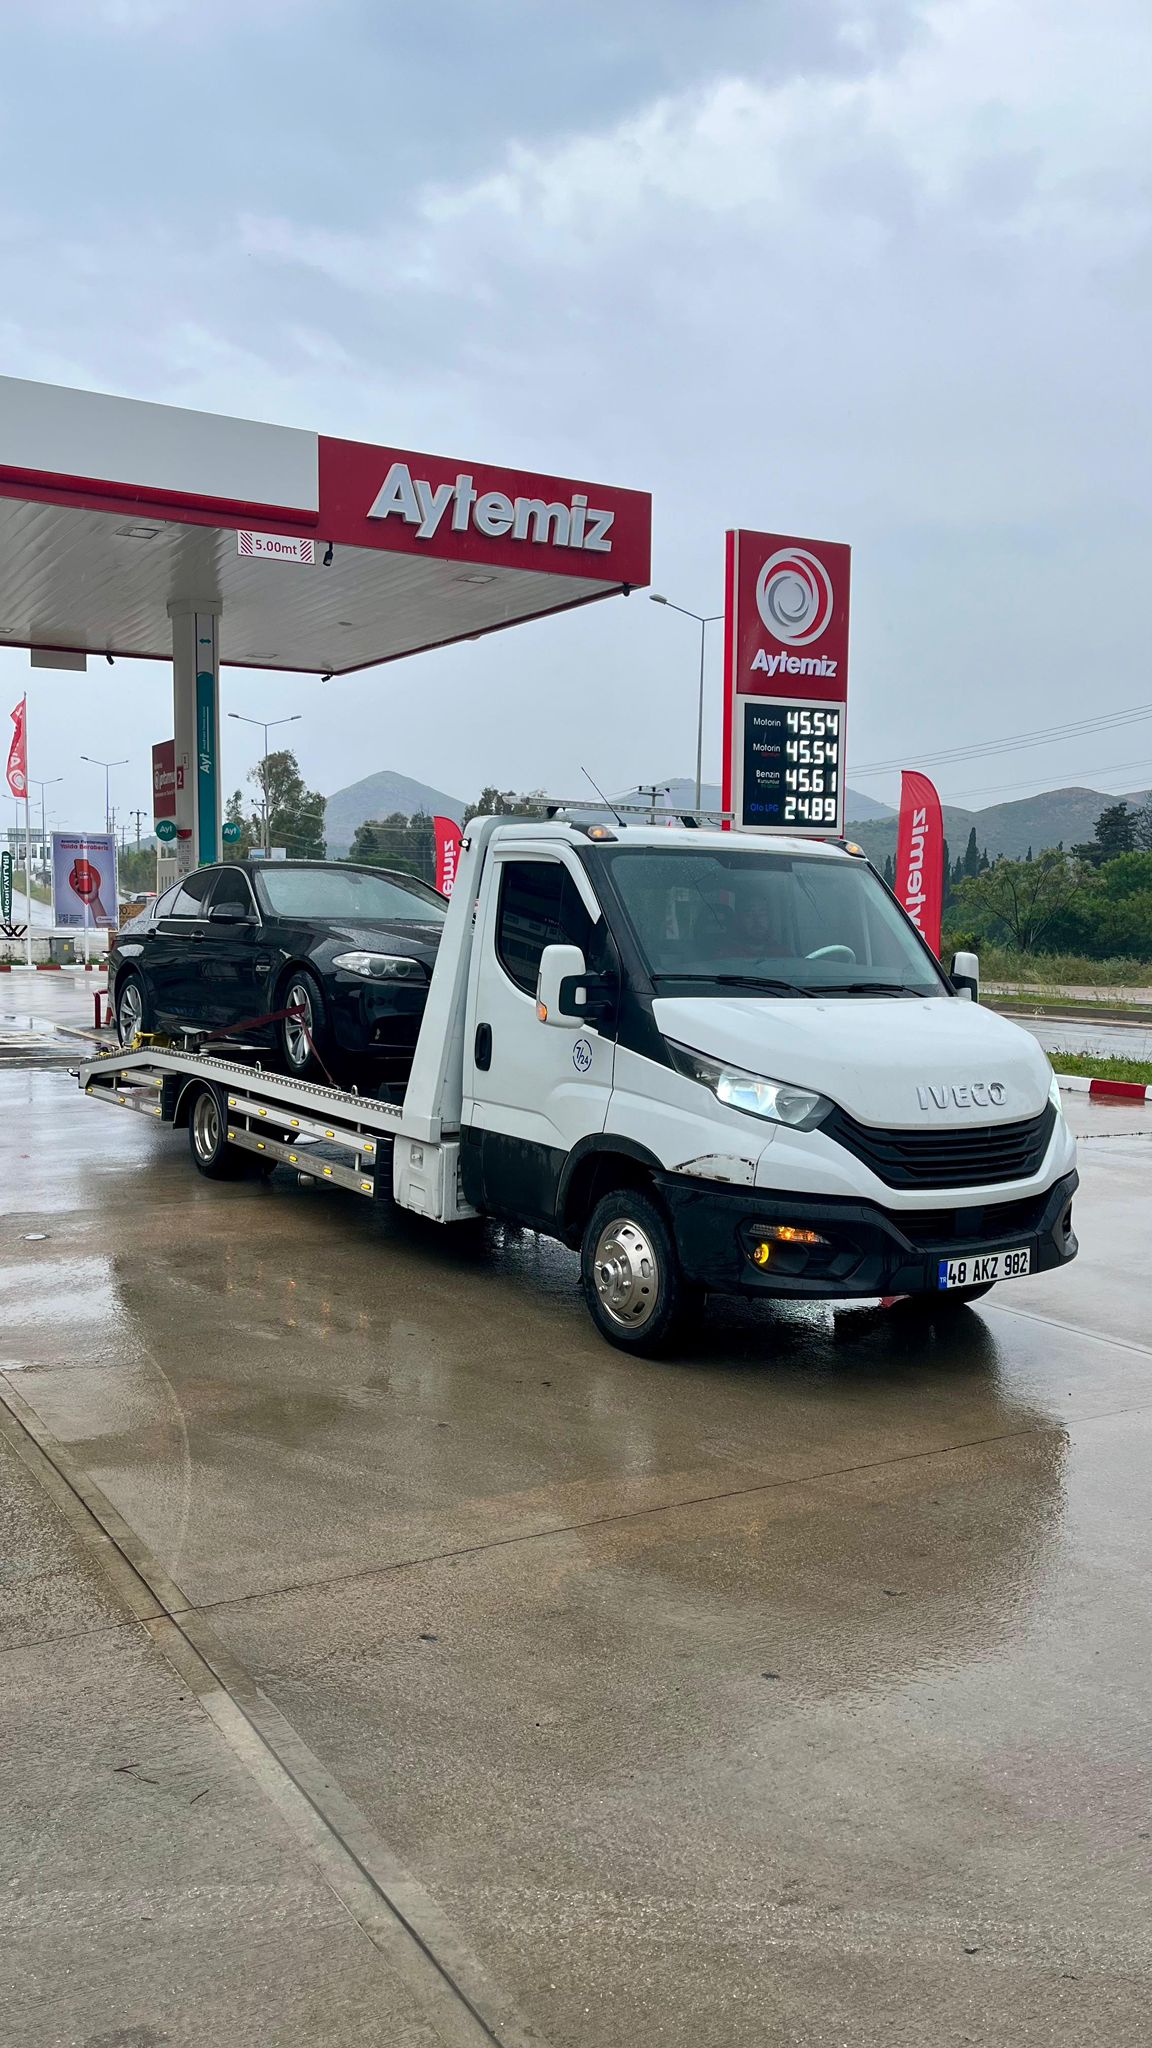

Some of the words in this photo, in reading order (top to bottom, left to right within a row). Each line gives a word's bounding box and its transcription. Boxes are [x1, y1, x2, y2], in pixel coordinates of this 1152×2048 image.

[367, 463, 615, 552] Aytemiz
[256, 539, 297, 555] 5.00mt
[750, 648, 838, 677] Aytemiz
[753, 717, 781, 727] Motorin
[787, 711, 838, 736] 45.54
[200, 753, 211, 774] Ayt
[752, 743, 781, 752] Motorin
[786, 740, 837, 764] 45.54
[178, 770, 183, 785] 2
[756, 769, 780, 779] Benzin
[785, 768, 837, 792] 45.61
[765, 803, 779, 812] LPG
[784, 796, 836, 821] 24.89
[160, 825, 173, 834] Ayt
[223, 827, 237, 836] Ayt
[576, 1046, 589, 1064] 7/24
[916, 1082, 1007, 1110] IVECO
[948, 1262, 967, 1285] 48
[973, 1257, 998, 1282] AKZ
[1004, 1252, 1028, 1276] 982
